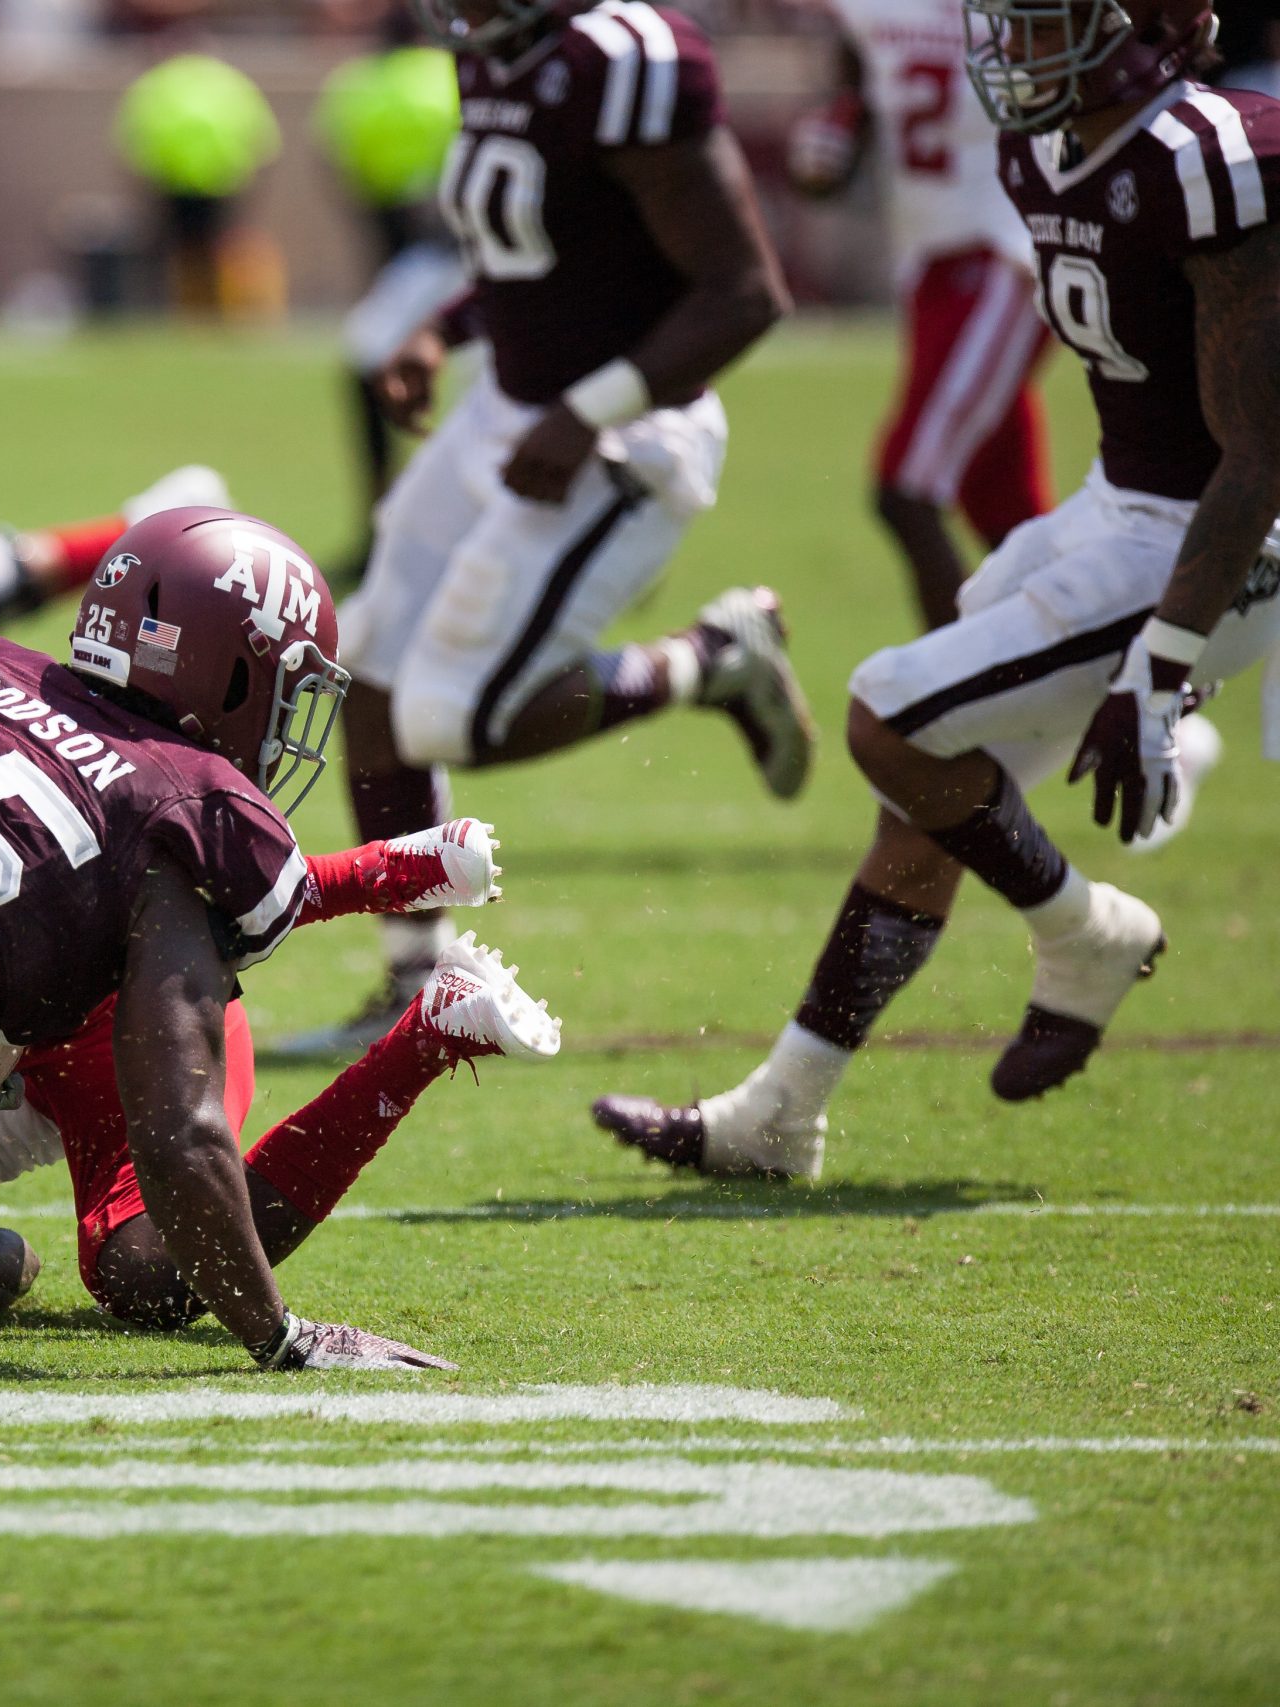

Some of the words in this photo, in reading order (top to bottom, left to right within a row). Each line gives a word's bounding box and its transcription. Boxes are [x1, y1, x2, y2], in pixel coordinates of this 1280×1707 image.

[84, 603, 117, 644] 25
[439, 971, 482, 994] adidas
[325, 1345, 364, 1358] adidas
